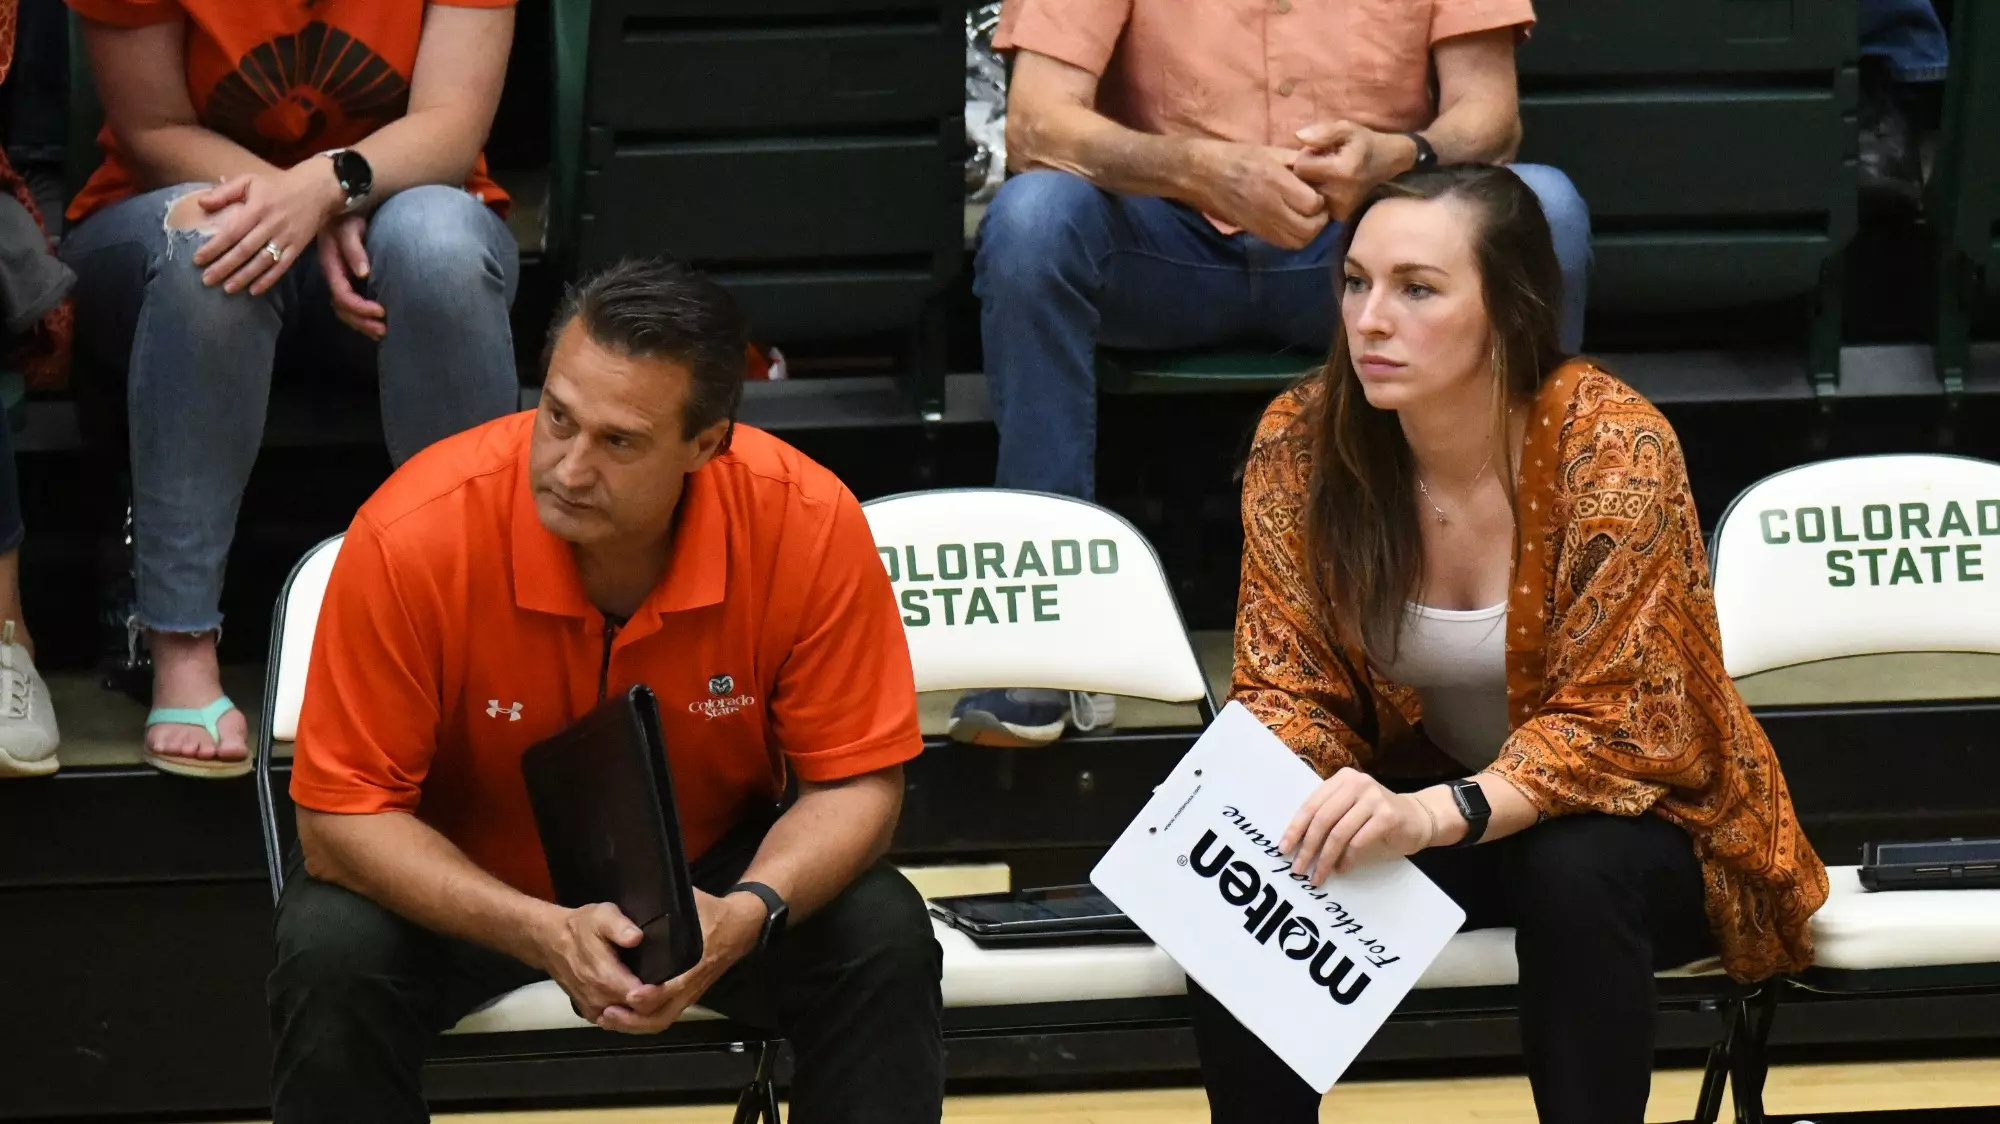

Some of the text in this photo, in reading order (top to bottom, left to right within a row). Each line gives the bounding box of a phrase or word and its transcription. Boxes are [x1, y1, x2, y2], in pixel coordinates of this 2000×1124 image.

[1759, 500, 2000, 545] COLORAD
[876, 538, 1119, 583] OLORADO
[1826, 543, 1984, 587] STATE
[900, 583, 1060, 627] STATE
[688, 694, 755, 713] Colorado
[1222, 805, 1286, 858] game
[1189, 829, 1372, 1005] molten
[1325, 901, 1363, 935] the
[1358, 937, 1400, 969] For
